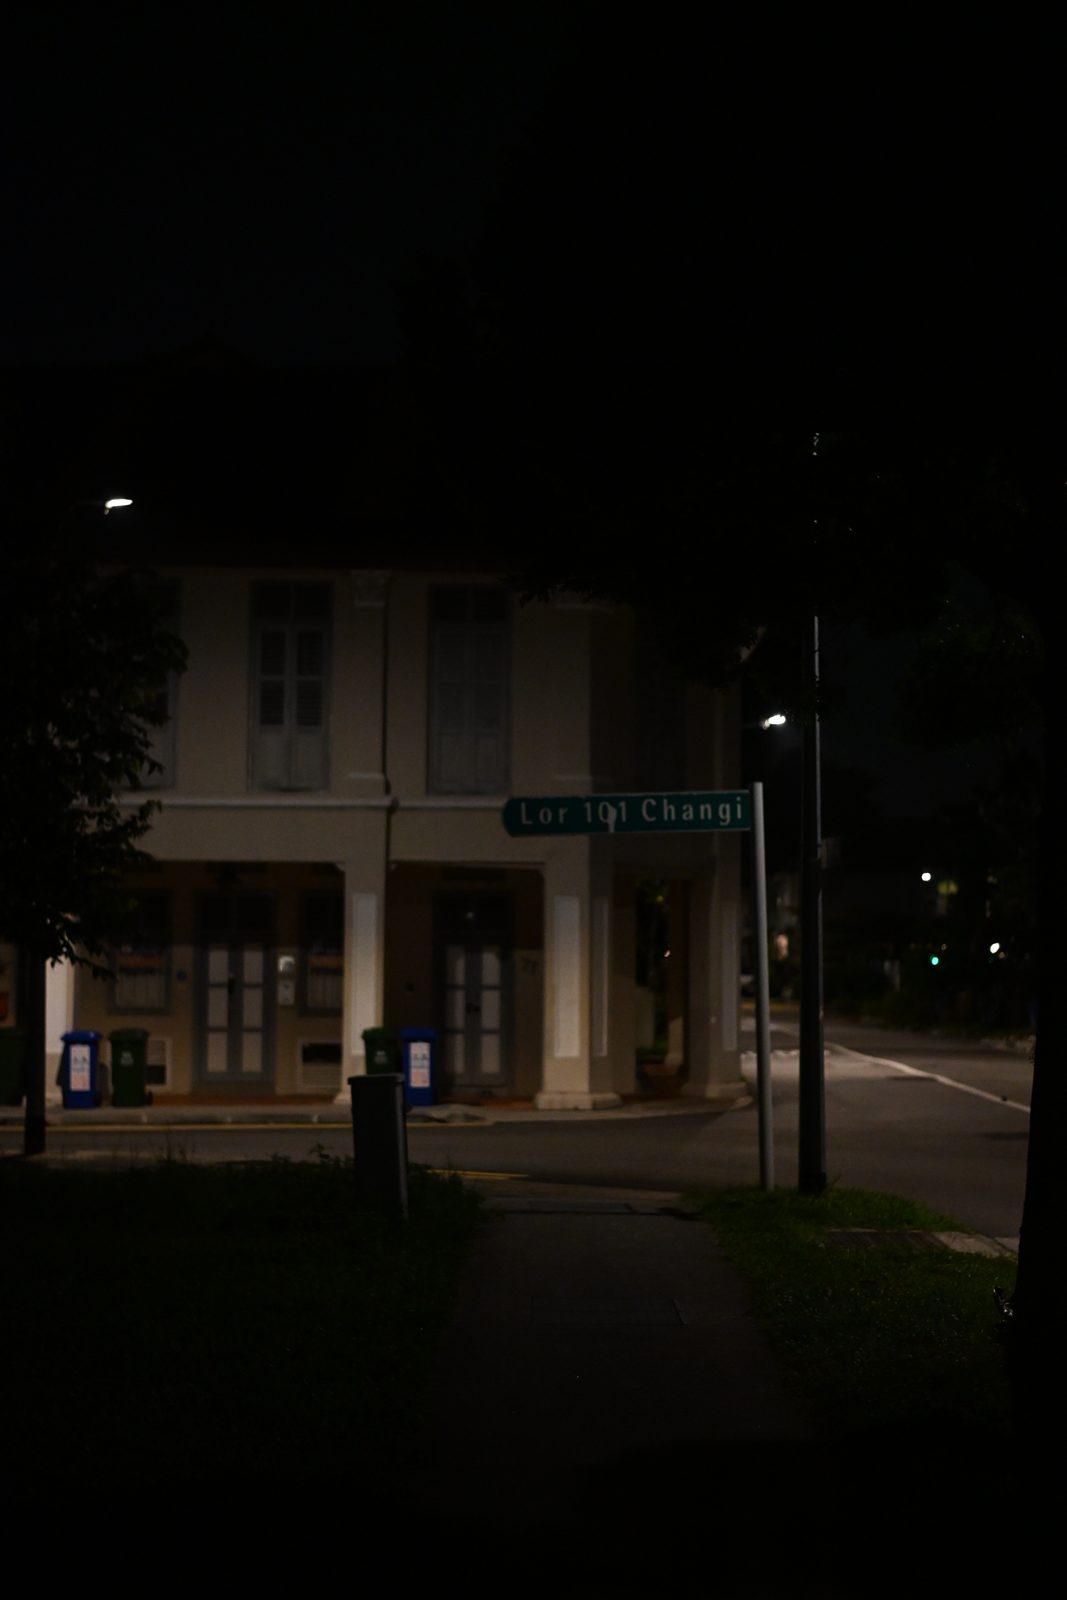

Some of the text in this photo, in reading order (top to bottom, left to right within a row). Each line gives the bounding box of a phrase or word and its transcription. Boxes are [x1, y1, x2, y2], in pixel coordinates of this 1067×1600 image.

[520, 796, 743, 826] Lor 101 Changi
